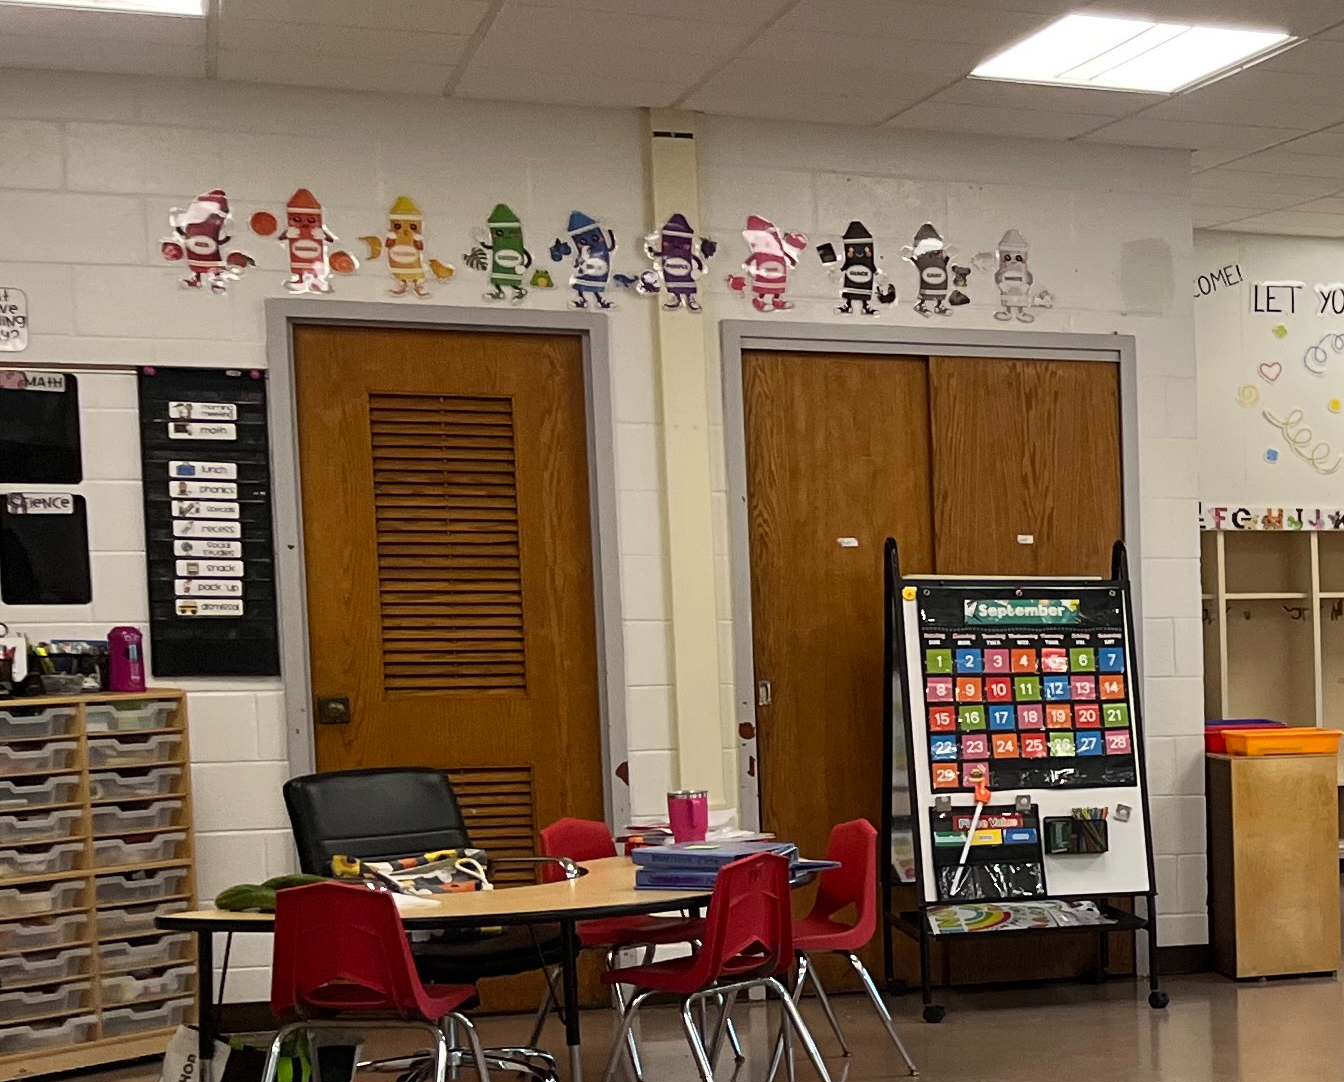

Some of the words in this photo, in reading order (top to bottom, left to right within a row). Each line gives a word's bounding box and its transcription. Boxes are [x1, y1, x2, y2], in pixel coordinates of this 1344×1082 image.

[1253, 285, 1302, 314] LET
[201, 465, 227, 474] lunch
[199, 485, 235, 495] phonics
[201, 525, 236, 534] recess
[198, 583, 221, 592] pack
[978, 605, 1065, 619] September
[936, 656, 943, 668] 1
[965, 656, 974, 668] 2
[993, 655, 1003, 667] 3
[1019, 655, 1028, 667] 4
[1078, 654, 1088, 666] 6
[1107, 654, 1116, 666] 7
[936, 684, 947, 696] 8
[965, 684, 975, 696] 9
[991, 683, 1007, 696] 10
[1020, 683, 1033, 695] 11
[1050, 682, 1064, 695] 12
[1076, 682, 1090, 694] 13
[1104, 681, 1118, 693] 14
[935, 712, 950, 725] 15
[964, 711, 980, 724] 16
[994, 711, 1009, 724] 17
[1023, 710, 1038, 723] 18
[1051, 710, 1066, 723] 19
[1079, 709, 1096, 722] 20
[1107, 709, 1122, 722] 21
[966, 740, 984, 754] 23
[996, 740, 1014, 753] 24
[1025, 739, 1043, 752] 25
[1080, 737, 1097, 751] 27
[1110, 736, 1126, 749] 28
[937, 769, 955, 782] 29
